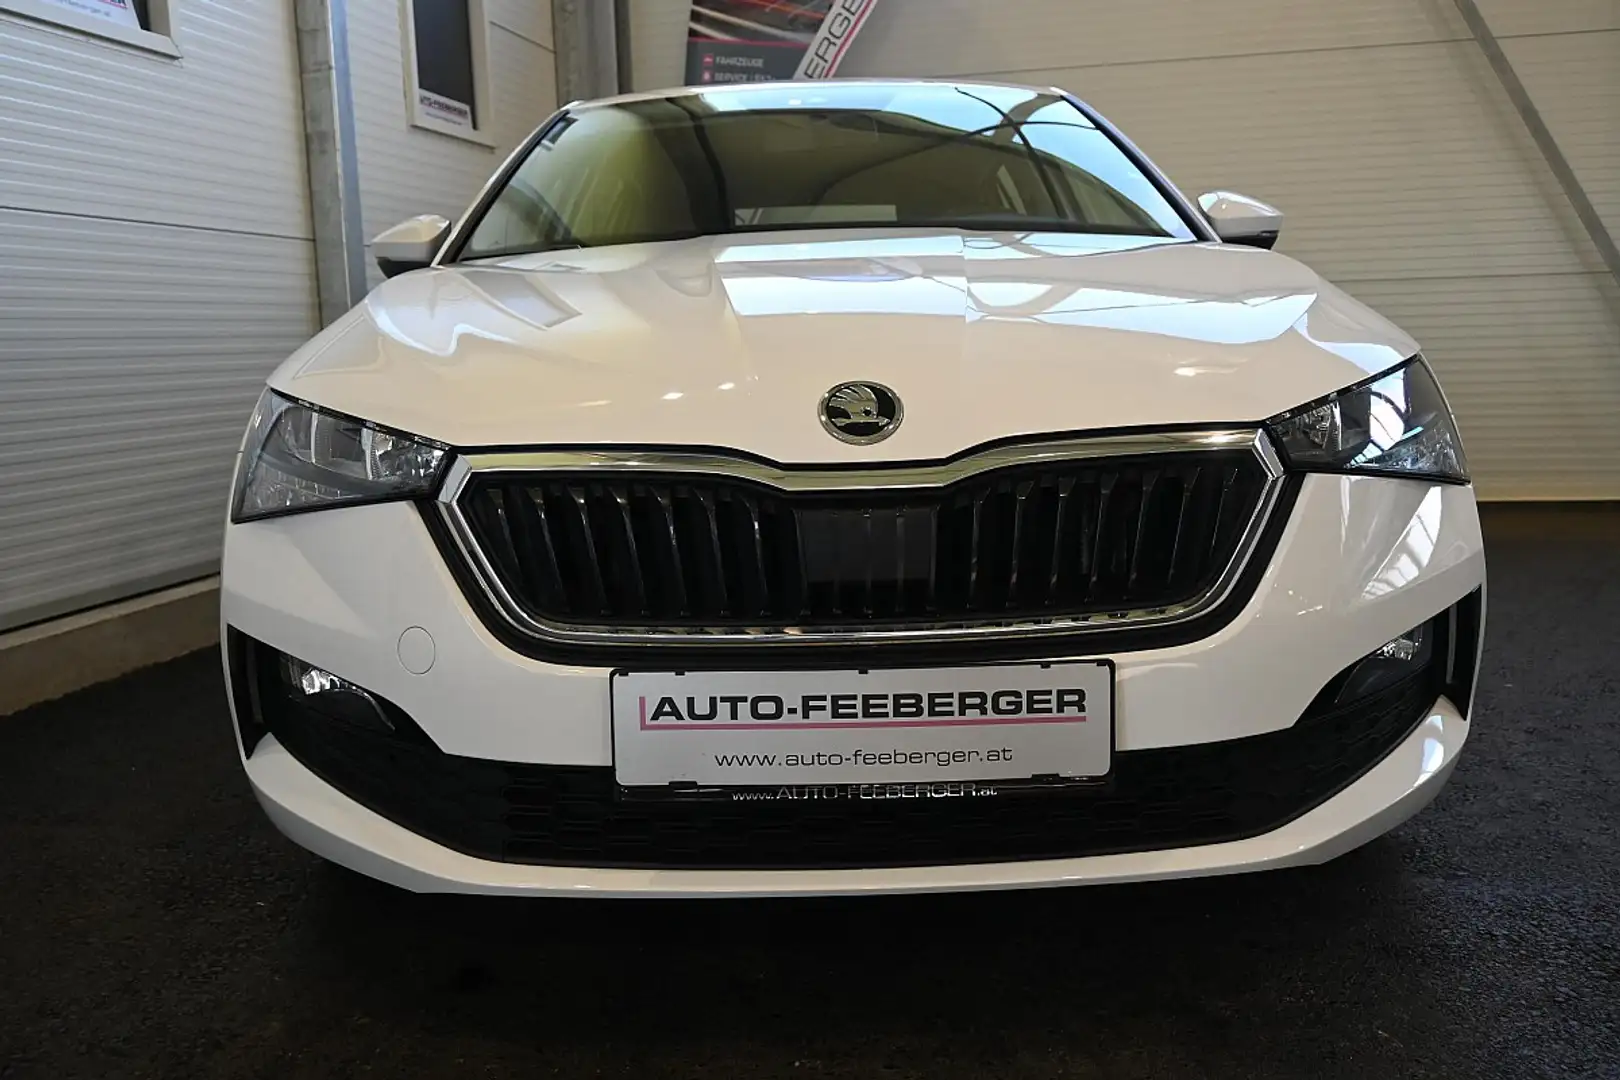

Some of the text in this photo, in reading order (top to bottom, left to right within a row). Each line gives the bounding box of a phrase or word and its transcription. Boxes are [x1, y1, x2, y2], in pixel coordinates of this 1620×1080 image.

[715, 56, 765, 68] FAHRZEUGE
[714, 72, 748, 83] SERVICE
[649, 688, 1087, 721] AUTO-FEEBERGER
[714, 746, 1014, 769] www.auto-feeberger.at
